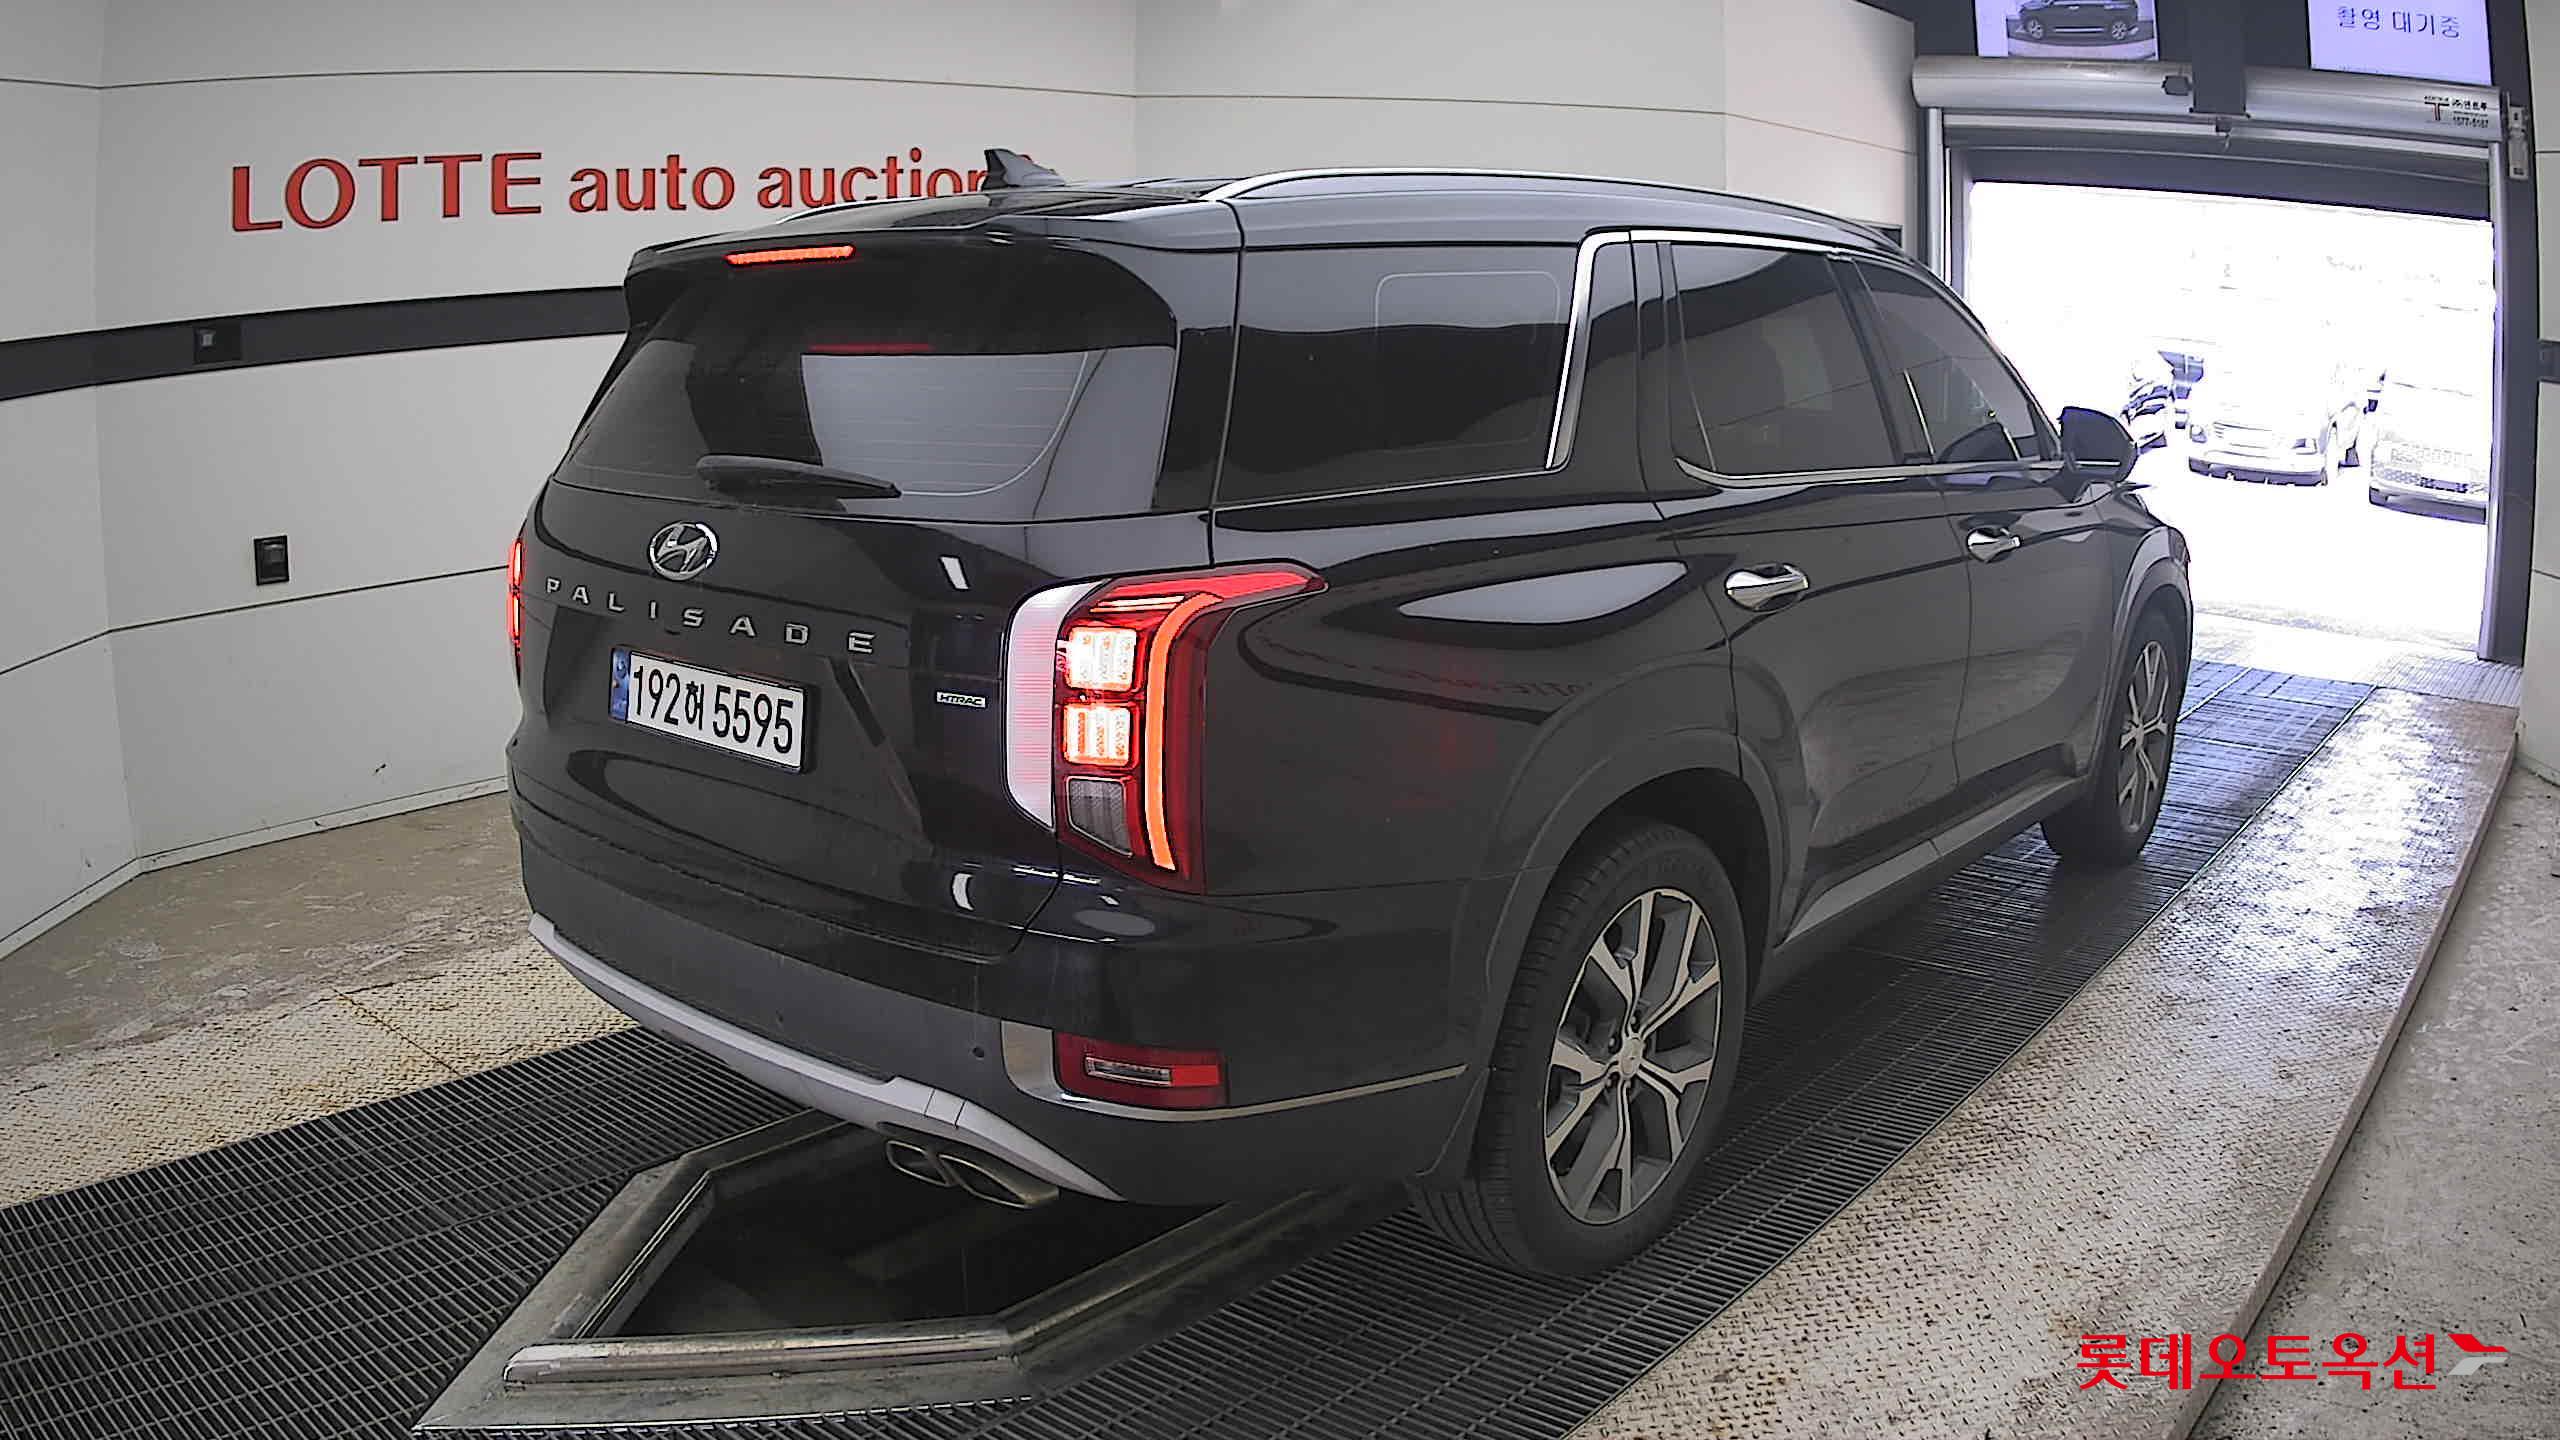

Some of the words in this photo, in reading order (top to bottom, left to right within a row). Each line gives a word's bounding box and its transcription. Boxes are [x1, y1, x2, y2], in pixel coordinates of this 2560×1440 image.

[231, 151, 543, 233] LOTTE
[567, 154, 736, 214] auto
[545, 577, 878, 654] PALISADE
[939, 693, 983, 706] HTRAC
